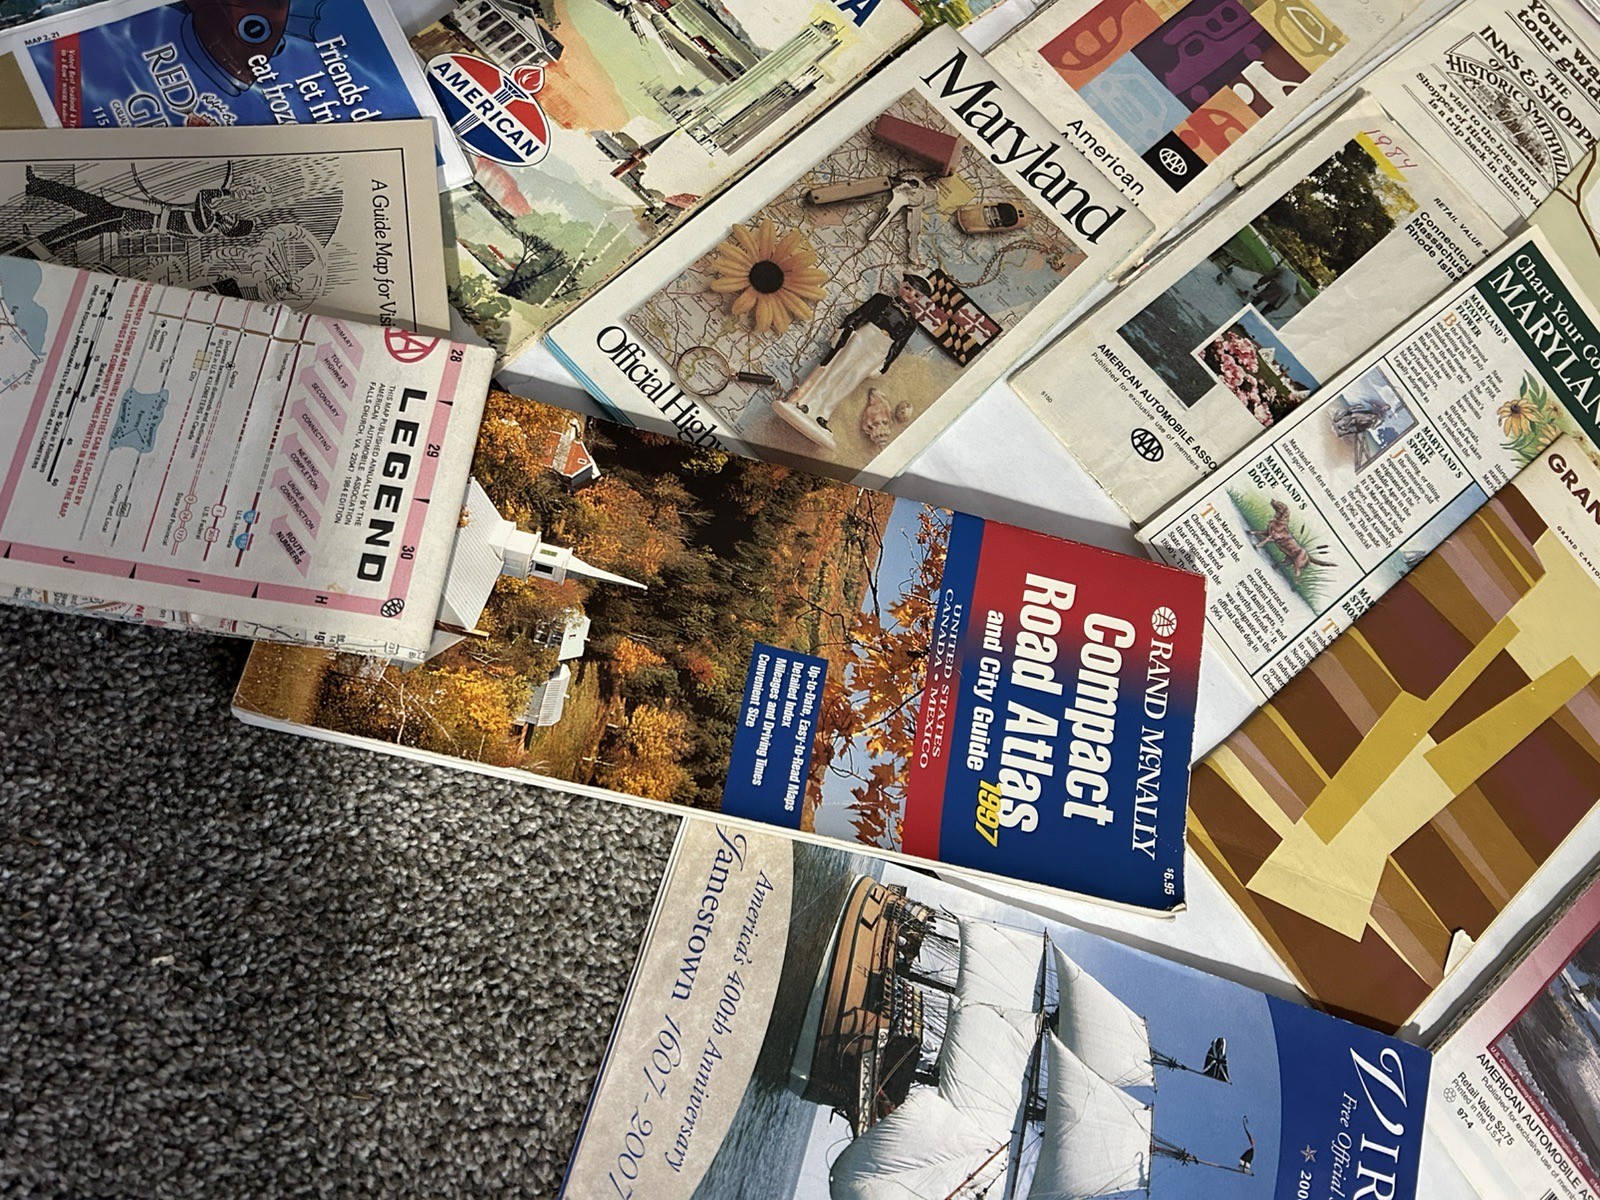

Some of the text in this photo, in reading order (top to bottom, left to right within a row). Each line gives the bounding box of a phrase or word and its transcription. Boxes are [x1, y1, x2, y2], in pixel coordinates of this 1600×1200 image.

[24, 36, 42, 46] MAP
[50, 31, 60, 39] 21
[1517, 9, 1560, 53] tour
[1527, 0, 1573, 46] Your
[144, 42, 199, 117] RED
[314, 34, 370, 106] Friends
[1446, 54, 1525, 99] HISTORIC
[1479, 25, 1525, 71] INNS
[1519, 68, 1540, 87] &
[1488, 58, 1510, 73] of
[1544, 68, 1572, 100] THE
[247, 54, 299, 127] eat froz
[295, 70, 326, 101] let
[432, 61, 540, 157] AMERICAN
[919, 46, 1127, 245] Maryland
[1415, 72, 1455, 114] Shoppes
[1454, 113, 1468, 125] of
[1465, 124, 1503, 165] Historic
[1438, 83, 1538, 187] A visit to the Inns and
[1066, 119, 1144, 196] American
[1428, 98, 1520, 201] is a trip back in time.
[371, 178, 388, 192] A
[372, 194, 391, 239] Guide
[1404, 223, 1436, 258] Rhode
[1433, 197, 1458, 224] RETAIL
[1459, 223, 1483, 248] VALUE
[372, 241, 393, 275] Map
[372, 276, 395, 300] for
[1462, 299, 1483, 323] STATE
[1515, 254, 1555, 304] Chart
[1551, 301, 1585, 344] Your
[1455, 304, 1482, 338] FLOWER
[1469, 293, 1509, 344] MARYLAND'S
[449, 348, 464, 363] 28
[596, 325, 677, 405] Official
[1417, 335, 1453, 381] Black-eyed Susan
[1430, 325, 1473, 382] hillsides and meadows
[310, 381, 340, 418] SECONDARY
[1090, 351, 1200, 471] Published for exclusive use of members.
[1097, 344, 1143, 390] AMERICAN
[1139, 389, 1195, 446] AUTOMOBILE
[301, 413, 332, 452] CONNECTING
[344, 382, 386, 526] AMERICAN AUTOMOBILE ASSOCIATION
[354, 385, 396, 527] THIS MAP PUBLISHED ANNUALLY BY THE
[426, 443, 441, 458] 29
[1130, 427, 1164, 463] AAA
[1406, 438, 1431, 466] SPORT
[1413, 432, 1436, 459] STATE
[1423, 425, 1463, 479] MARYLAND'S
[356, 387, 428, 582] LEGEND
[1247, 468, 1266, 489] DOG
[1255, 461, 1279, 488] STATE
[1264, 454, 1307, 511] MARYLAND'S
[1386, 457, 1421, 505] equestrian sport,
[226, 509, 243, 549] U.S. Interstate
[400, 545, 415, 560] 30
[1557, 525, 1578, 550] GRAND
[1246, 573, 1285, 627] excellent hunters,
[745, 653, 771, 728] Convenient Size
[781, 661, 805, 728] Detailed Index
[919, 588, 954, 769] CANADA MEXICO
[932, 604, 963, 758] UNITED STATES
[966, 609, 1004, 771] and City Guide
[997, 572, 1077, 836] Road Atlas
[1144, 637, 1174, 720] RAND
[751, 657, 788, 786] Mileages and Driving Times
[783, 665, 821, 812] Up-to-Date, Easy-to-Read Maps
[1063, 613, 1136, 826] Compact
[969, 778, 1006, 848] 1997
[1163, 867, 1175, 896] $6.95
[670, 823, 749, 1000] Jamestown
[664, 869, 774, 1172] America's 400th Anniversary
[1456, 1107, 1474, 1129] 97-4
[1457, 1071, 1515, 1146] Retail Value $2.75
[1476, 1053, 1582, 1190] AMERICAN AUTOMOBILE
[1330, 1091, 1358, 1198] Free Official
